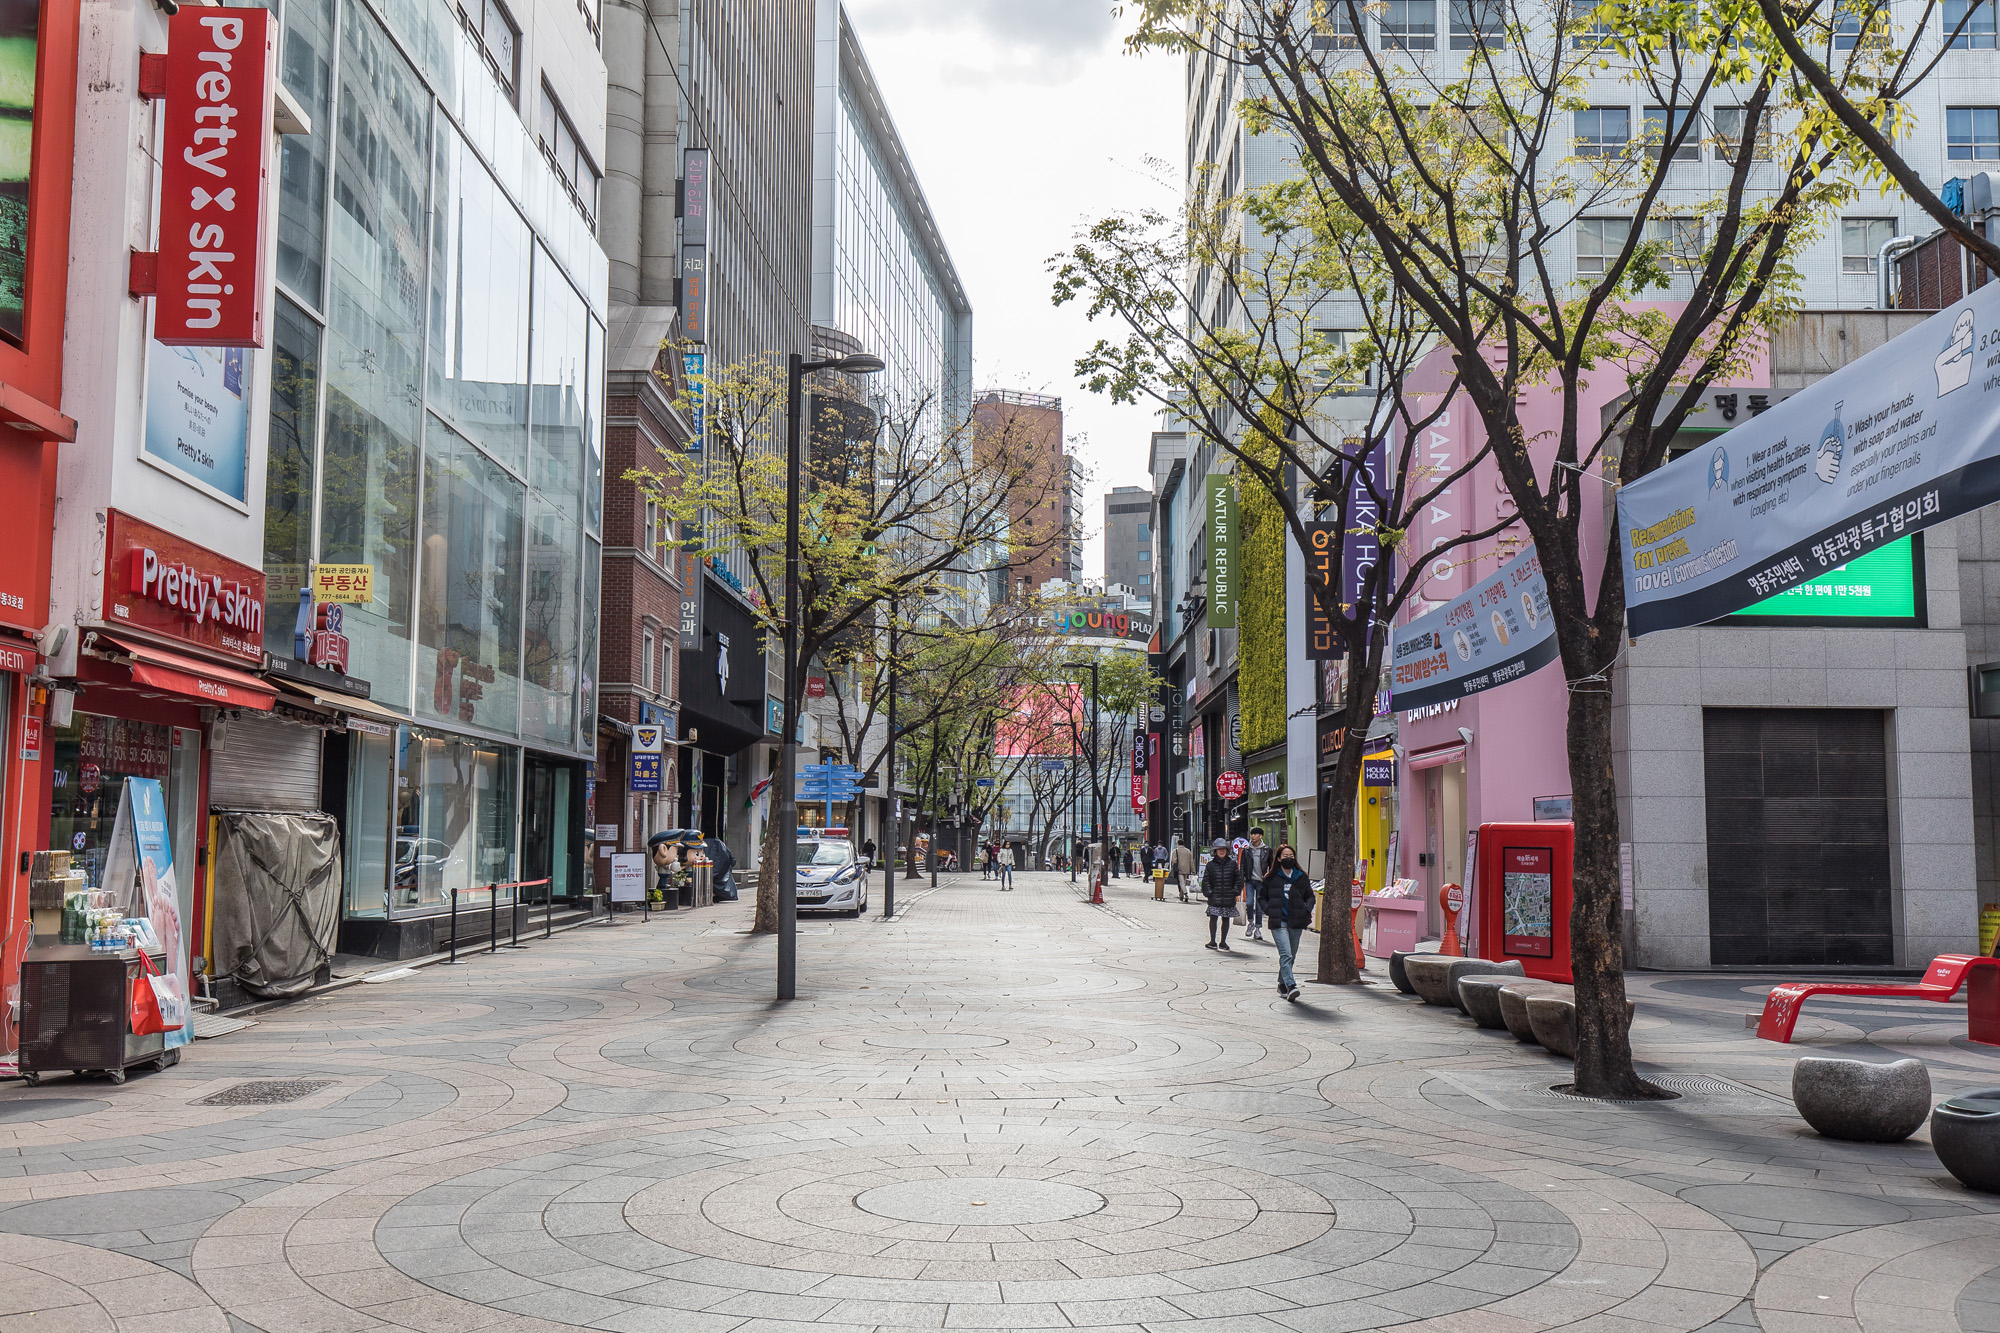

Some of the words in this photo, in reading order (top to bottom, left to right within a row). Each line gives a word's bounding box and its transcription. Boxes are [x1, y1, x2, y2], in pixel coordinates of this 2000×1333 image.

[184, 17, 244, 178] Pretty
[688, 159, 703, 217] 산부인과
[185, 222, 235, 329] skin
[684, 258, 704, 272] 치과
[688, 277, 698, 297] 연세
[688, 301, 698, 331] 미소래
[177, 381, 194, 400] Promise
[194, 393, 204, 406] your
[204, 399, 219, 417] beauty
[1714, 393, 1790, 420] 명동
[1855, 414, 1872, 435] Wash
[1873, 406, 1890, 428] your
[1890, 392, 1914, 415] hands
[1752, 448, 1766, 464] Wear
[1771, 435, 1788, 455] mask
[1850, 449, 1881, 477] especially
[1880, 443, 1897, 464] your
[1896, 433, 1920, 456] palms
[1920, 420, 1937, 441] and
[1853, 436, 1867, 456] with
[1868, 429, 1885, 448] soap
[1885, 417, 1900, 438] and
[1900, 409, 1924, 430] water
[177, 436, 196, 463] Pretty
[201, 454, 215, 470] skin
[1730, 477, 1745, 491] when
[1745, 467, 1765, 485] visiting
[1766, 457, 1785, 475] health
[1785, 443, 1811, 466] facilities
[1732, 491, 1745, 507] with
[1746, 479, 1776, 502] respiratory
[1777, 463, 1807, 488] symptoms
[1778, 487, 1790, 505] etc)
[1846, 478, 1865, 498] under
[1864, 471, 1881, 491] your
[1215, 487, 1227, 543] NATURE
[1431, 536, 1454, 581] CO
[1747, 556, 1805, 596] 명동주민센터
[1811, 489, 1941, 567] 명동관광특구협의회
[1633, 550, 1654, 571] for
[1635, 565, 1673, 593] novel
[1703, 539, 1739, 570] infection
[143, 548, 210, 624] Pretty
[224, 581, 262, 634] skin
[319, 575, 368, 591] 부동산
[1215, 548, 1227, 614] REPUBLIC
[1804, 584, 1814, 596] 한
[1814, 584, 1832, 596] 편에
[1834, 585, 1848, 596] 1만
[1848, 585, 1872, 597] 5천원
[0, 592, 24, 610] 동3호점
[326, 602, 344, 635] 32
[680, 601, 697, 636] 안과
[1054, 611, 1128, 637] young
[1395, 651, 1449, 684] 국민예방수칙
[198, 679, 214, 696] Pretty
[217, 684, 228, 697] skin
[82, 726, 96, 738] SALE
[1135, 735, 1144, 769] CHICOR
[634, 770, 658, 778] 파출소
